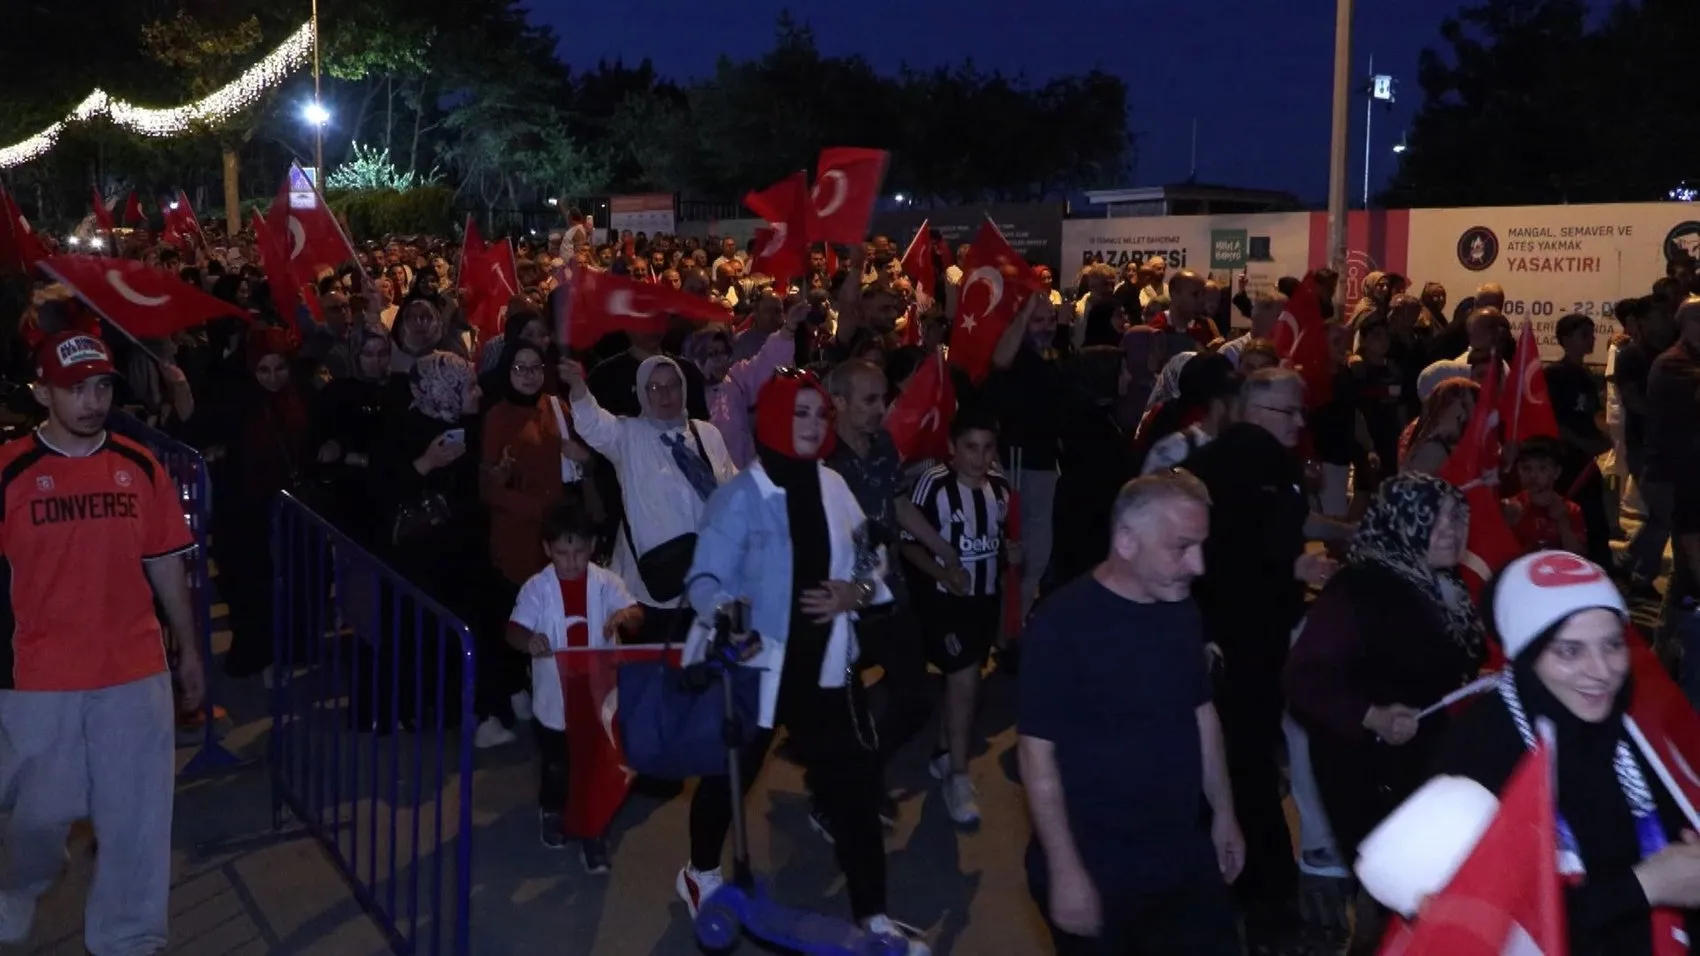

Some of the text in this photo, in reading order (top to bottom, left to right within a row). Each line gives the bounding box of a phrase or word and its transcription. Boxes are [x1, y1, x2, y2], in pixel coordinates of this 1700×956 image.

[1560, 226, 1613, 237] SEMAVER
[1617, 225, 1633, 236] VE
[1507, 240, 1581, 252] ATEŞ YAKMAK
[1507, 257, 1600, 272] YASAKTIR!
[30, 493, 138, 526] CONVERSE
[960, 535, 999, 551] beko
